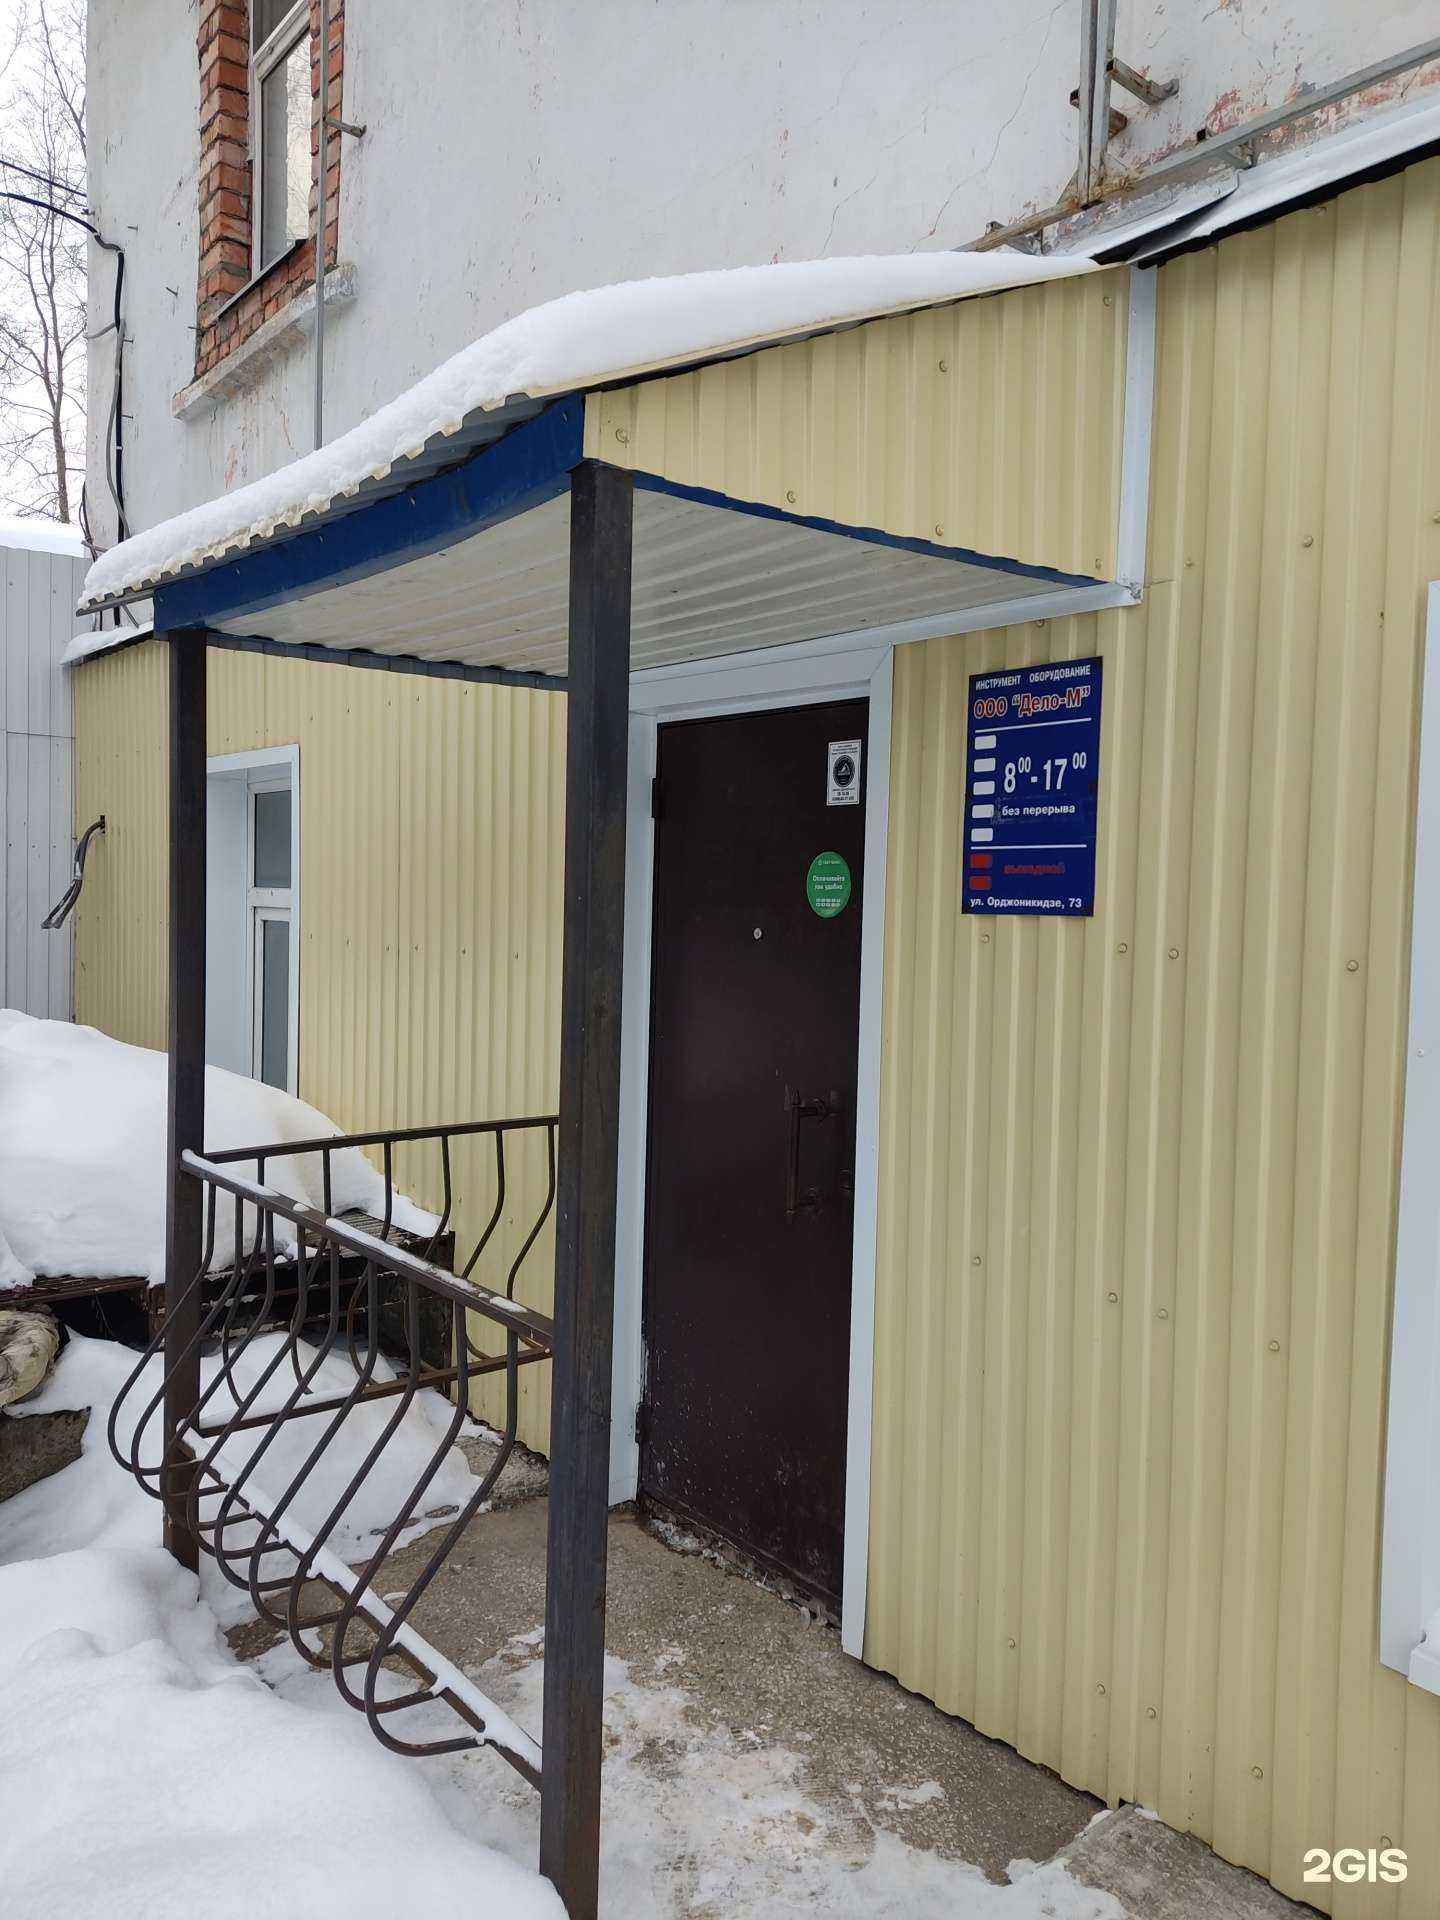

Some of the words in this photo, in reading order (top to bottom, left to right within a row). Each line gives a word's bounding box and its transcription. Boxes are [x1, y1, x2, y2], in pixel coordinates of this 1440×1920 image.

[975, 674, 1021, 691] ИНСТРУМЕНТ
[1029, 664, 1091, 683] ОБОРУДОВАНИЕ
[973, 697, 1008, 719] ООО
[1002, 805, 1020, 816] без
[1022, 804, 1076, 817] перерыва
[969, 897, 984, 908] ул.
[987, 896, 1065, 909] Орджоникидзе,
[1068, 897, 1082, 908] 73
